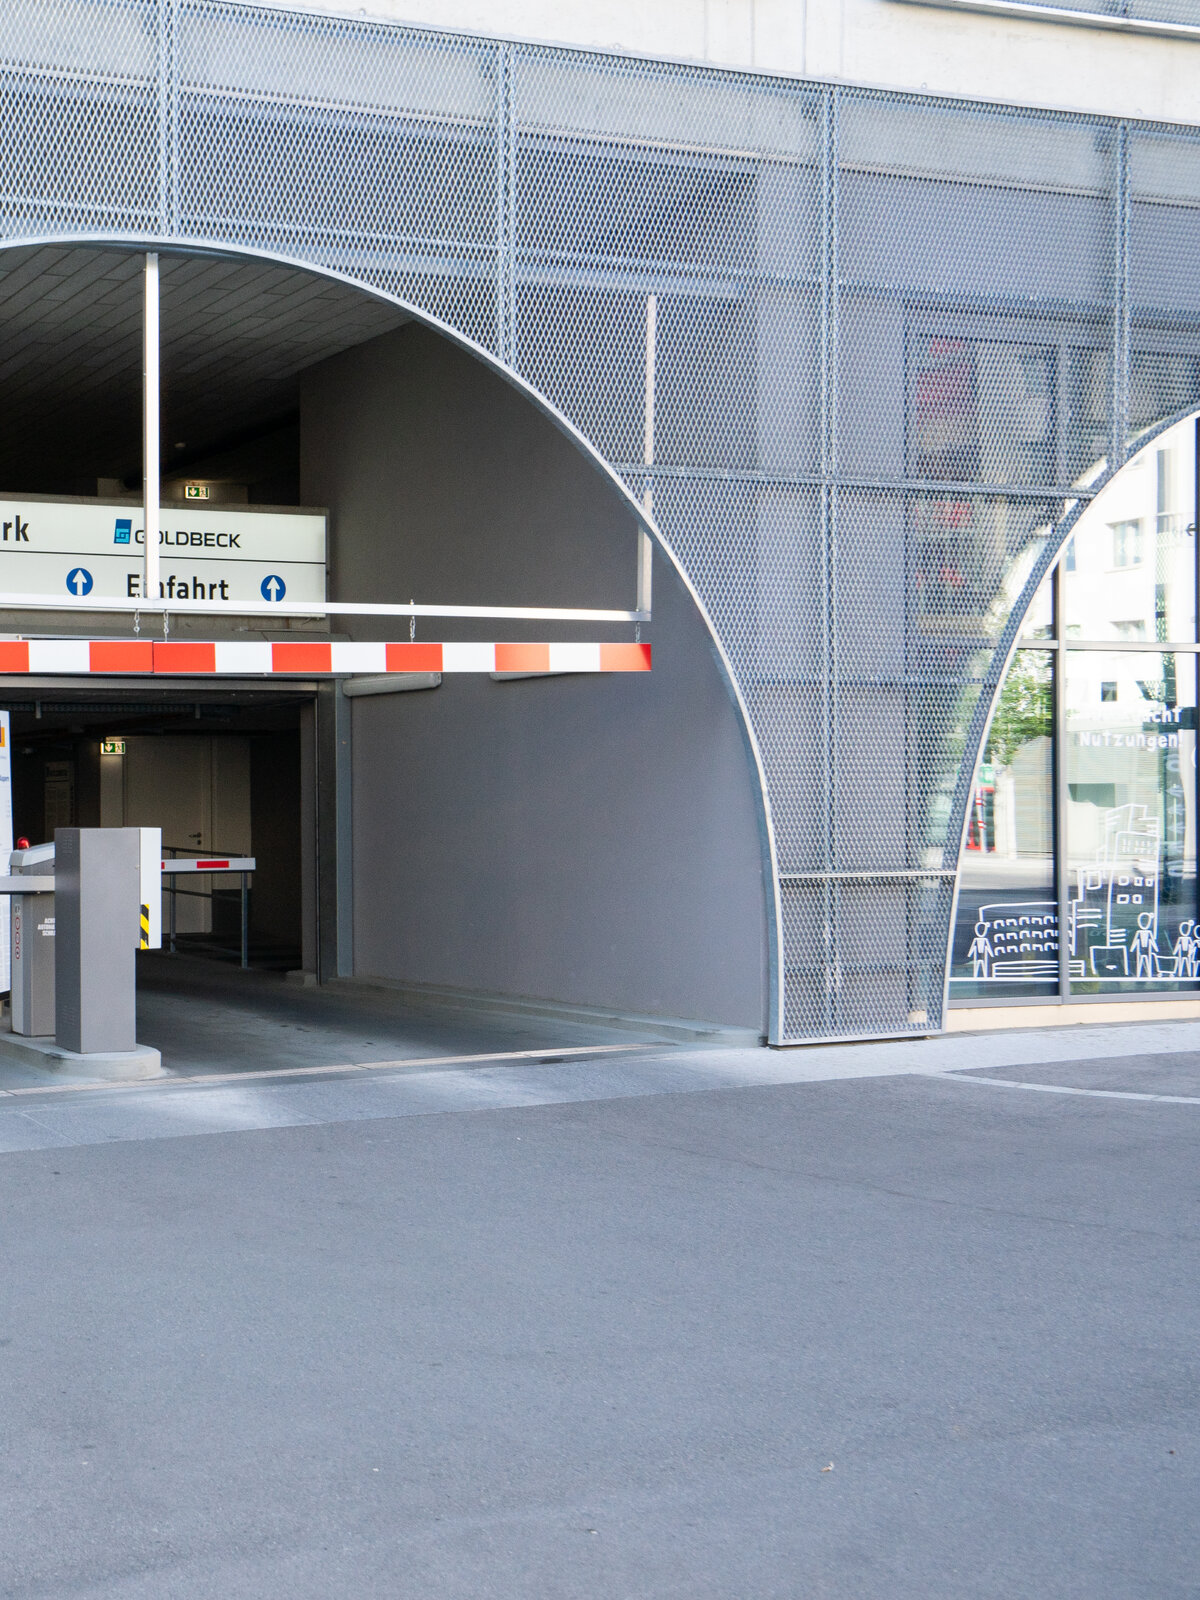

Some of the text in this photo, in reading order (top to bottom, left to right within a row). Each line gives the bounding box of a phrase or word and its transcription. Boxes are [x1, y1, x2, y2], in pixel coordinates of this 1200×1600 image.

[134, 529, 242, 549] GLDBECK
[127, 573, 229, 601] Efahrt
[1080, 730, 1184, 752] Nutzungen!
